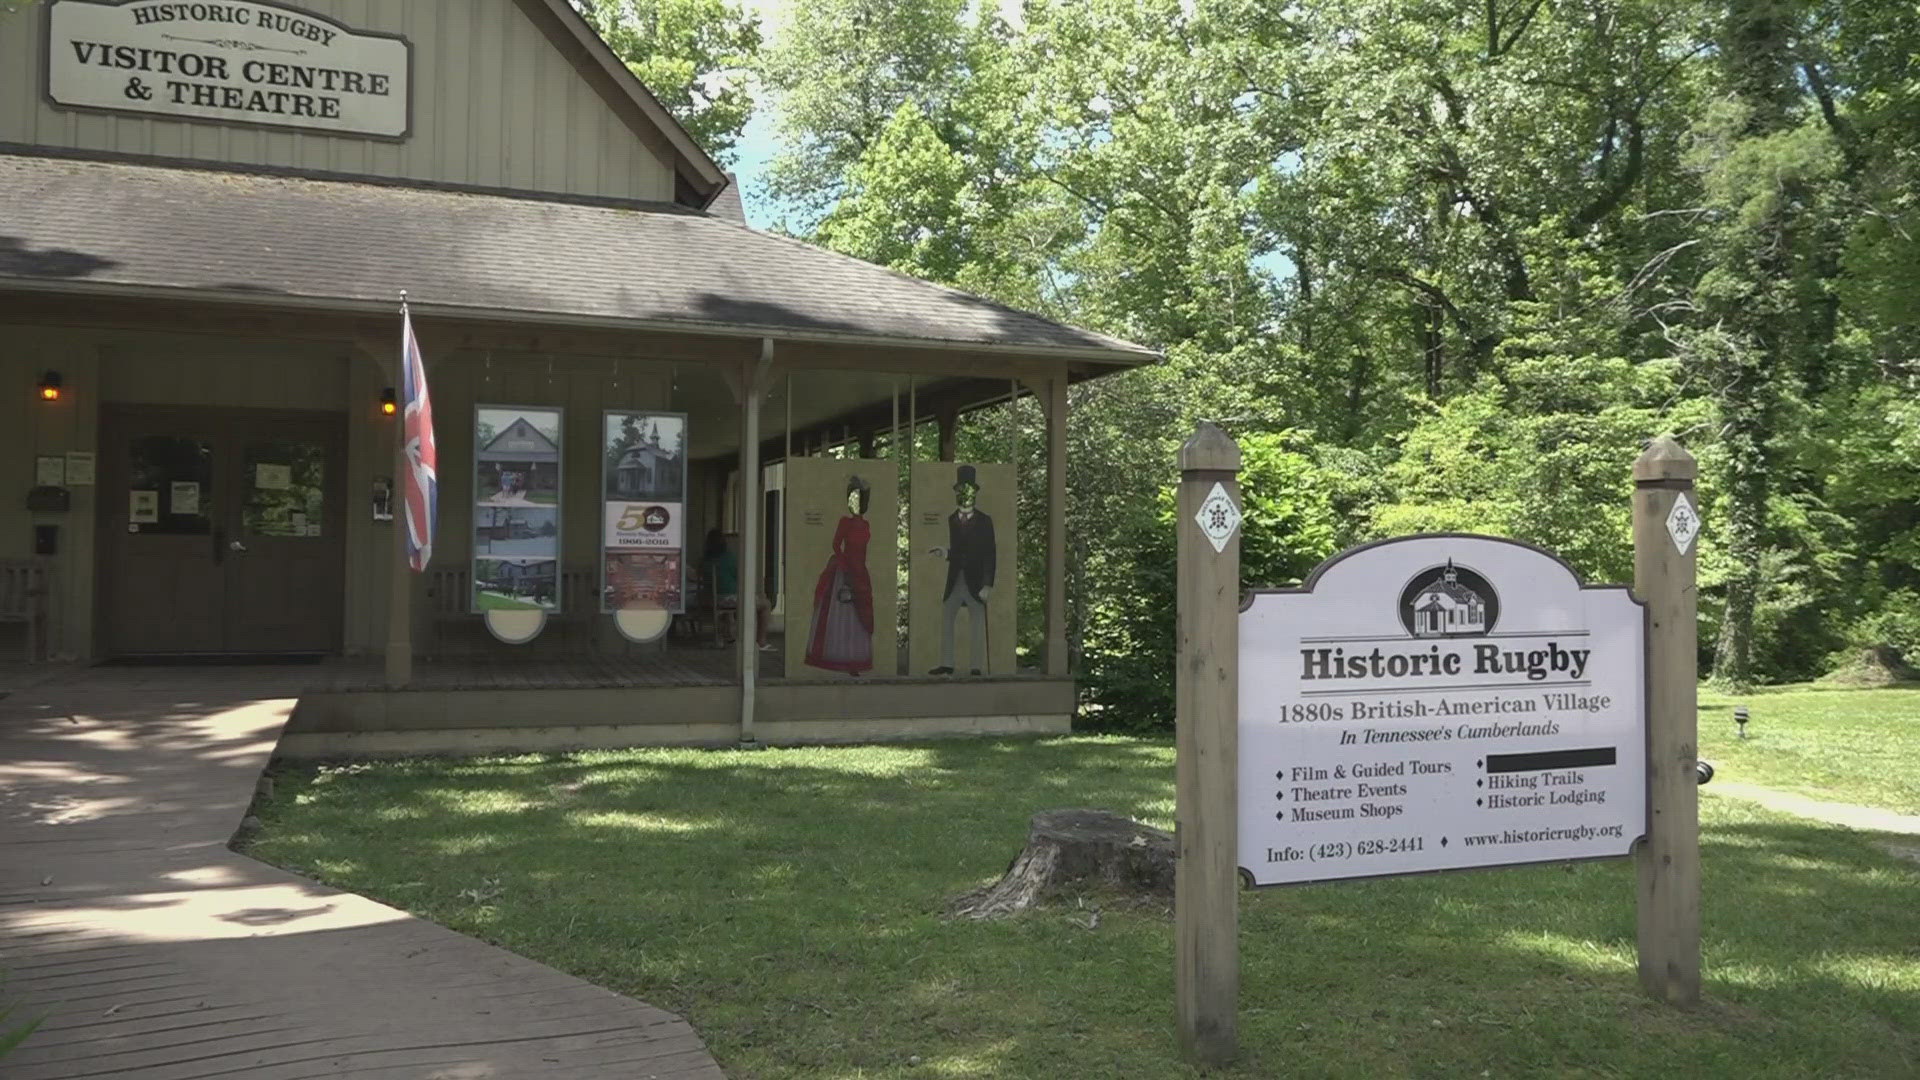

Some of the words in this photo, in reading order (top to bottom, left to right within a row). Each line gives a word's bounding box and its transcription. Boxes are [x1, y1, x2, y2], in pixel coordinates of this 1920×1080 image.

[132, 5, 250, 25] HISTORIC
[257, 7, 337, 47] RUGBY
[71, 41, 230, 79] VISITOR
[243, 60, 390, 96] CENTRE
[124, 78, 153, 101] &
[167, 81, 340, 118] THEATRE
[1300, 645, 1461, 680] Historic
[1474, 642, 1591, 681] Rugby
[1278, 703, 1344, 723] 1880s
[1351, 696, 1536, 721] British-American
[1543, 694, 1611, 713] Village
[1339, 730, 1357, 746] In
[1363, 725, 1452, 744] Tennessee's
[1457, 720, 1560, 739] Cumberlands
[1291, 766, 1329, 782] Film
[1334, 765, 1347, 778] &
[1352, 762, 1404, 778] Guided
[1409, 760, 1452, 775] Tours
[1488, 774, 1537, 792] Hiking
[1541, 771, 1584, 787] Trails
[1291, 787, 1353, 802] Theatre
[1358, 783, 1407, 798] Events
[1488, 793, 1545, 809] Historic
[1549, 789, 1605, 808] Lodging
[1291, 806, 1355, 823] Museum
[1360, 803, 1403, 822] Shops
[1464, 823, 1623, 847] www.historicrugby.org
[1267, 846, 1304, 863] Info:
[1309, 842, 1353, 862] (423)
[1358, 837, 1424, 856] 628-2441
